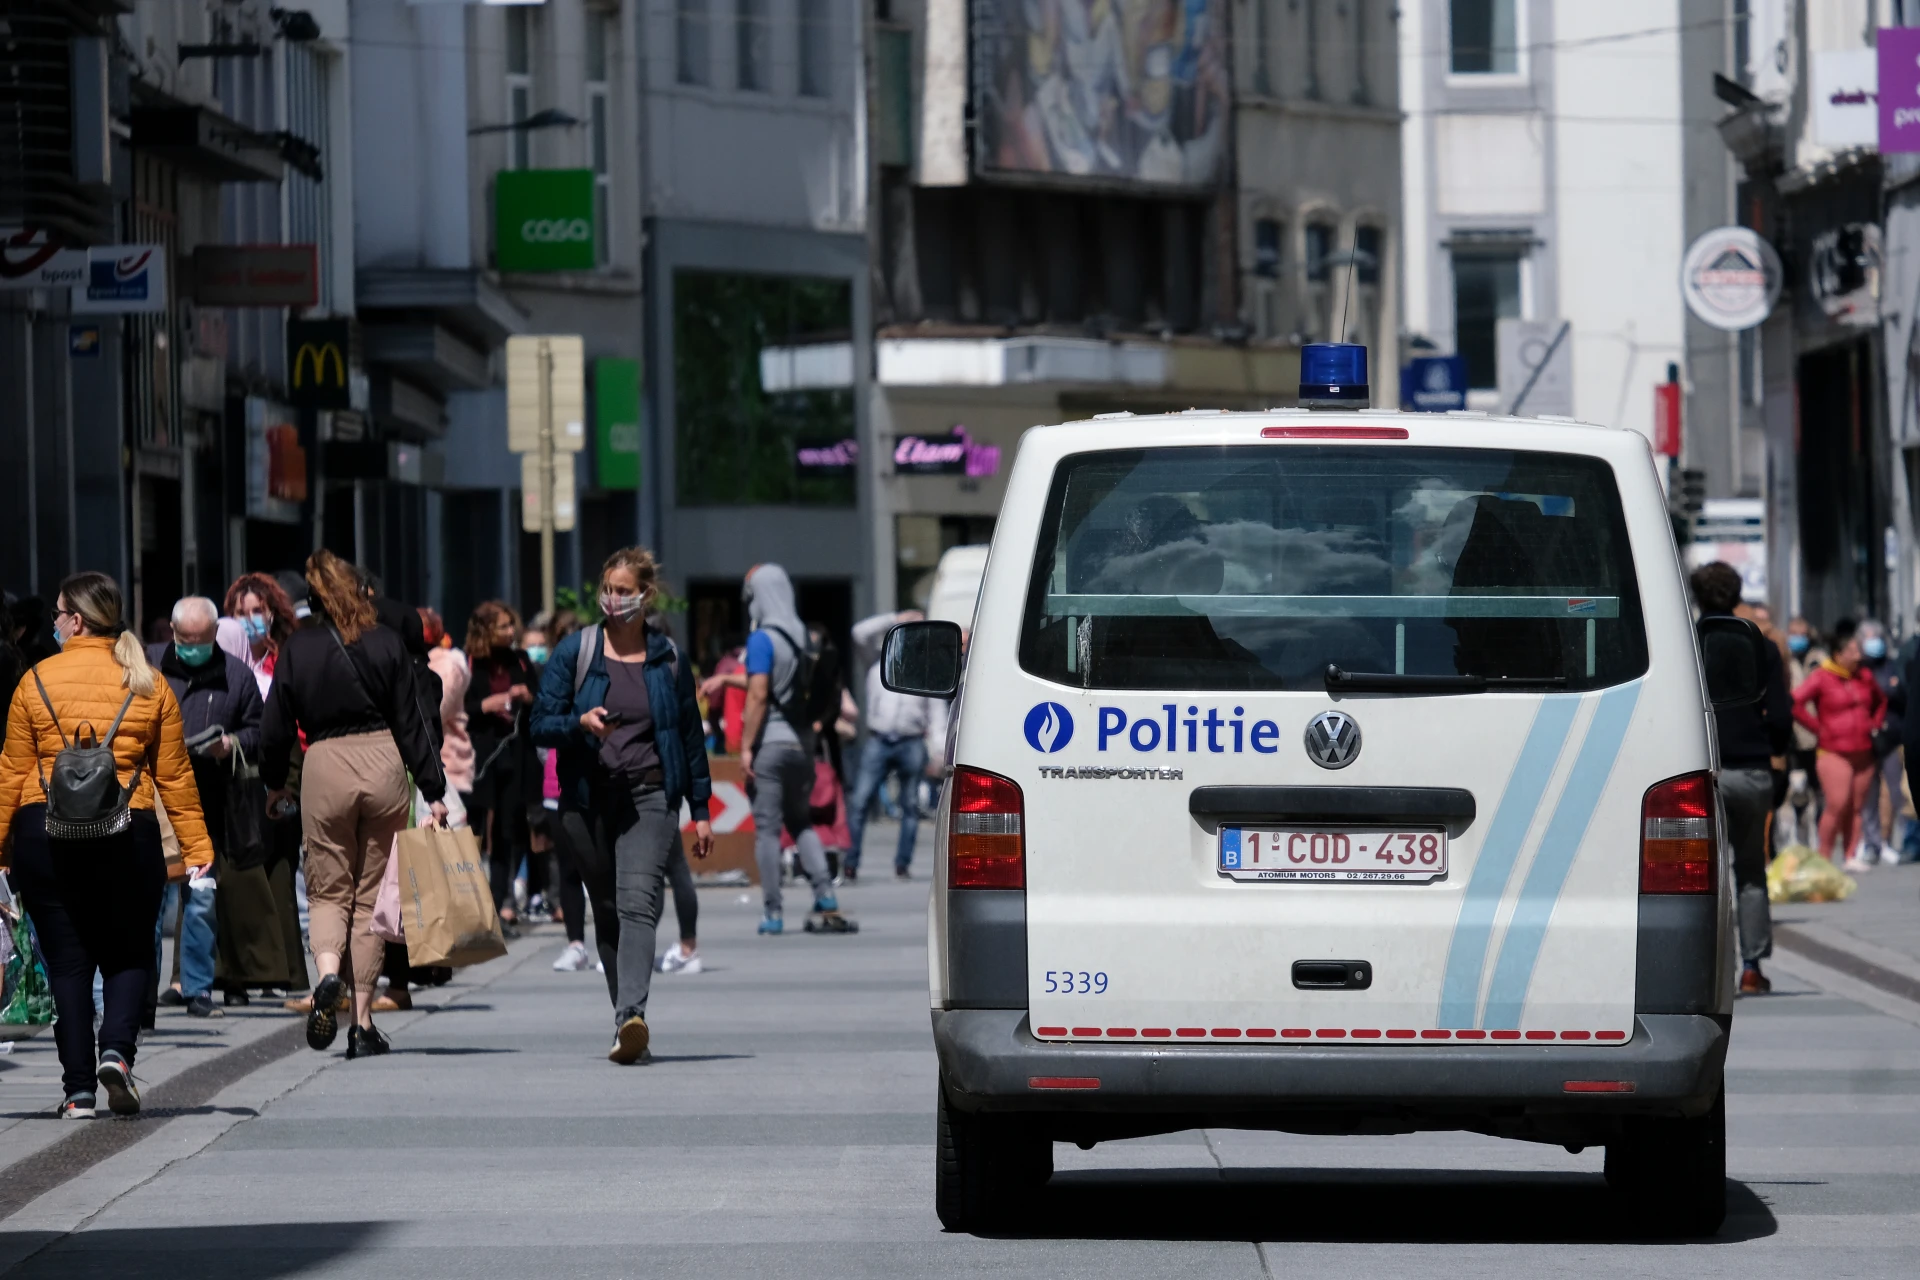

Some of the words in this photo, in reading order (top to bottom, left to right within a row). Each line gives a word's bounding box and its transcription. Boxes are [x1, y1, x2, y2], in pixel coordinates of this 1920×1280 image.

[521, 218, 590, 242] casa
[41, 268, 83, 283] bpost
[894, 435, 964, 465] Etam
[1098, 704, 1280, 753] Politie
[1038, 765, 1184, 781] TRANSPORTER
[1225, 851, 1238, 866] B
[1247, 832, 1438, 865] 1-COD-438
[1257, 871, 1297, 879] ATOMIUM
[1346, 872, 1406, 880] 02/267.29.66
[1044, 970, 1109, 994] 5339
